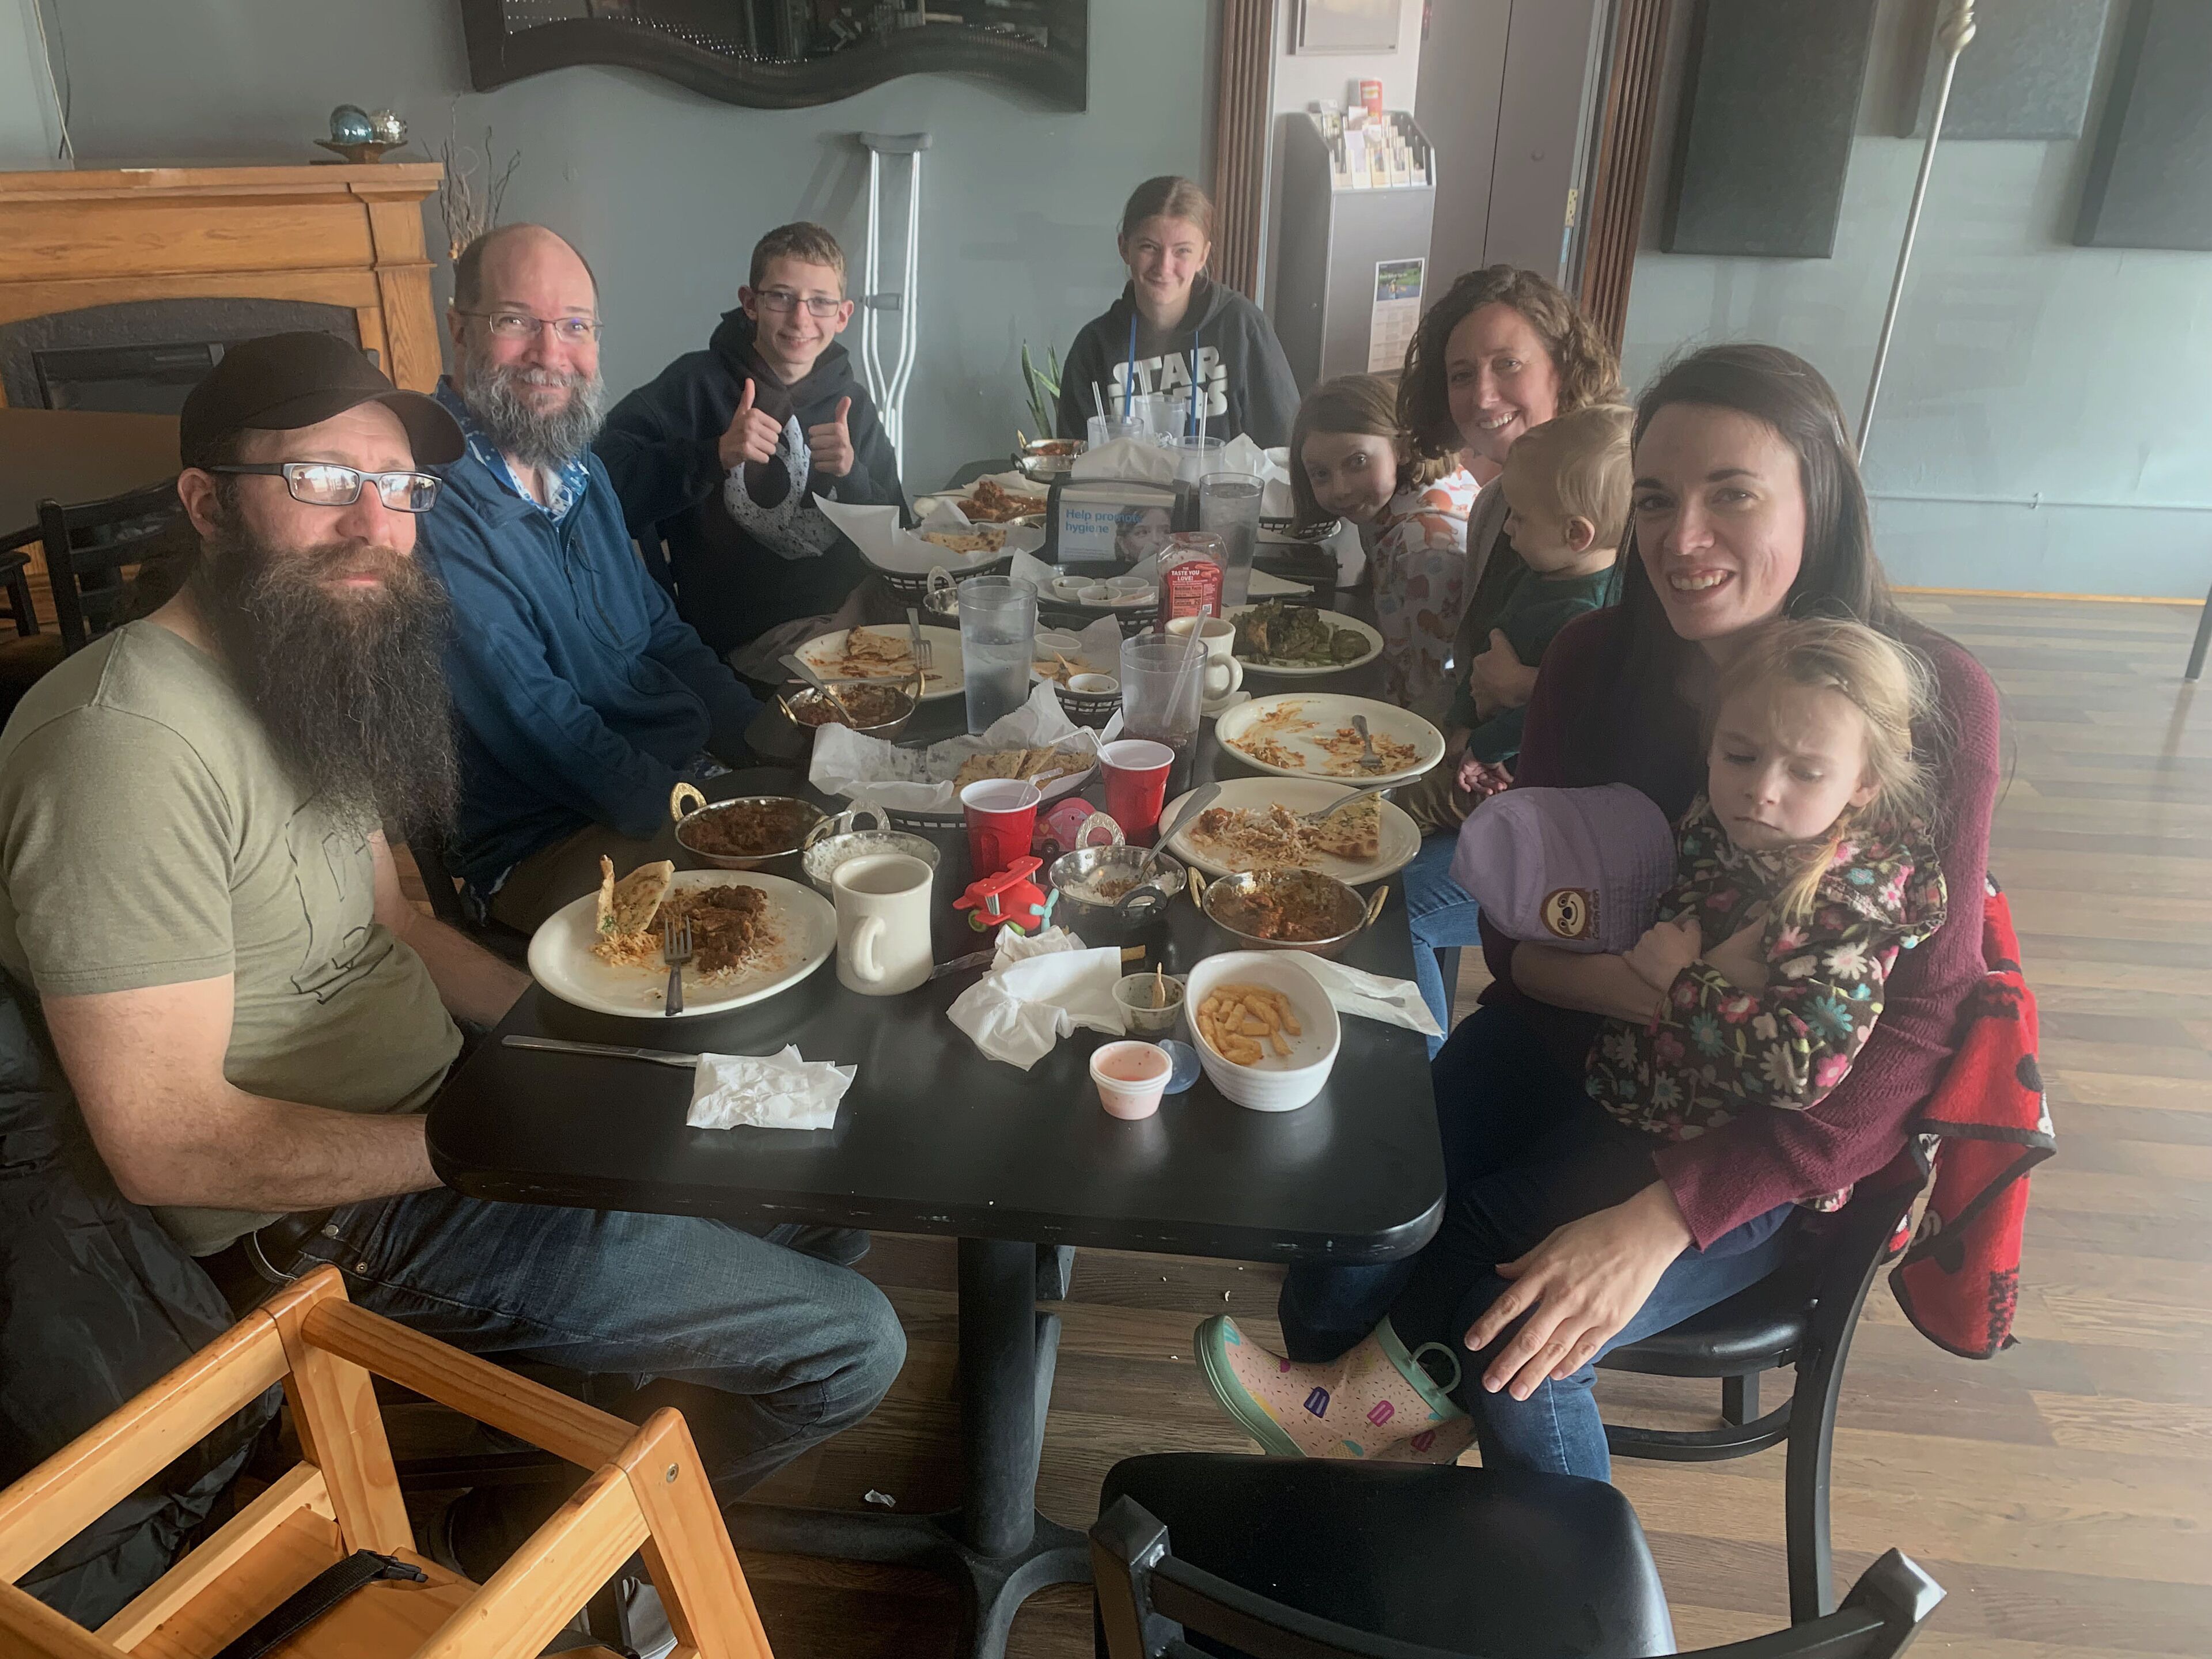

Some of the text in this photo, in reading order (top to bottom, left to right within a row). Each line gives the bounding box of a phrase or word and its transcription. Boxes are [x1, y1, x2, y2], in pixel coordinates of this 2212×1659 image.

[1108, 346, 1228, 397] STAR
[1066, 509, 1142, 524] Help promote
[1066, 522, 1109, 533] hygiene
